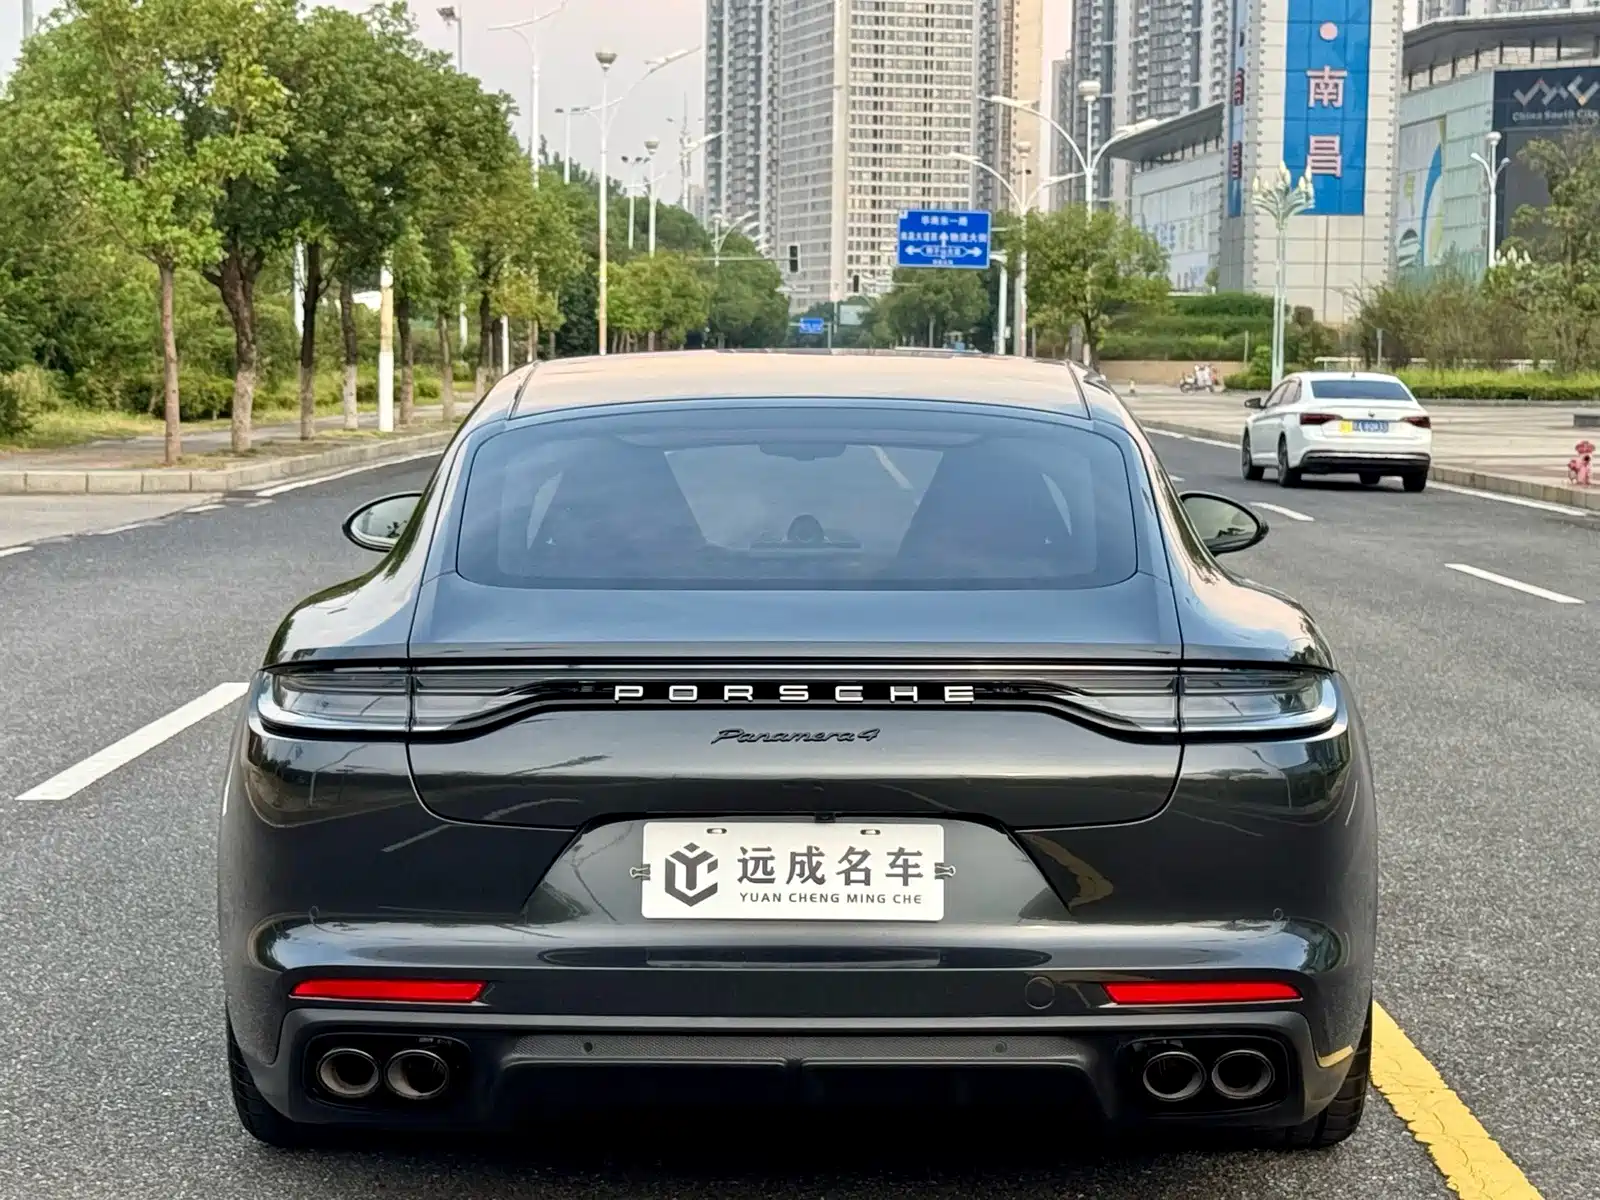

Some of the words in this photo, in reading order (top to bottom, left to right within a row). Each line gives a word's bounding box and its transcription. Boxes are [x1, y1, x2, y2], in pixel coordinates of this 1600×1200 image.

[1305, 65, 1348, 179] 南昌
[613, 685, 975, 702] PORSCHE
[737, 845, 924, 886] 远成名车
[740, 892, 782, 903] YUAN
[788, 892, 840, 903] CHENG
[846, 893, 886, 904] MING
[892, 894, 922, 904] CHE
